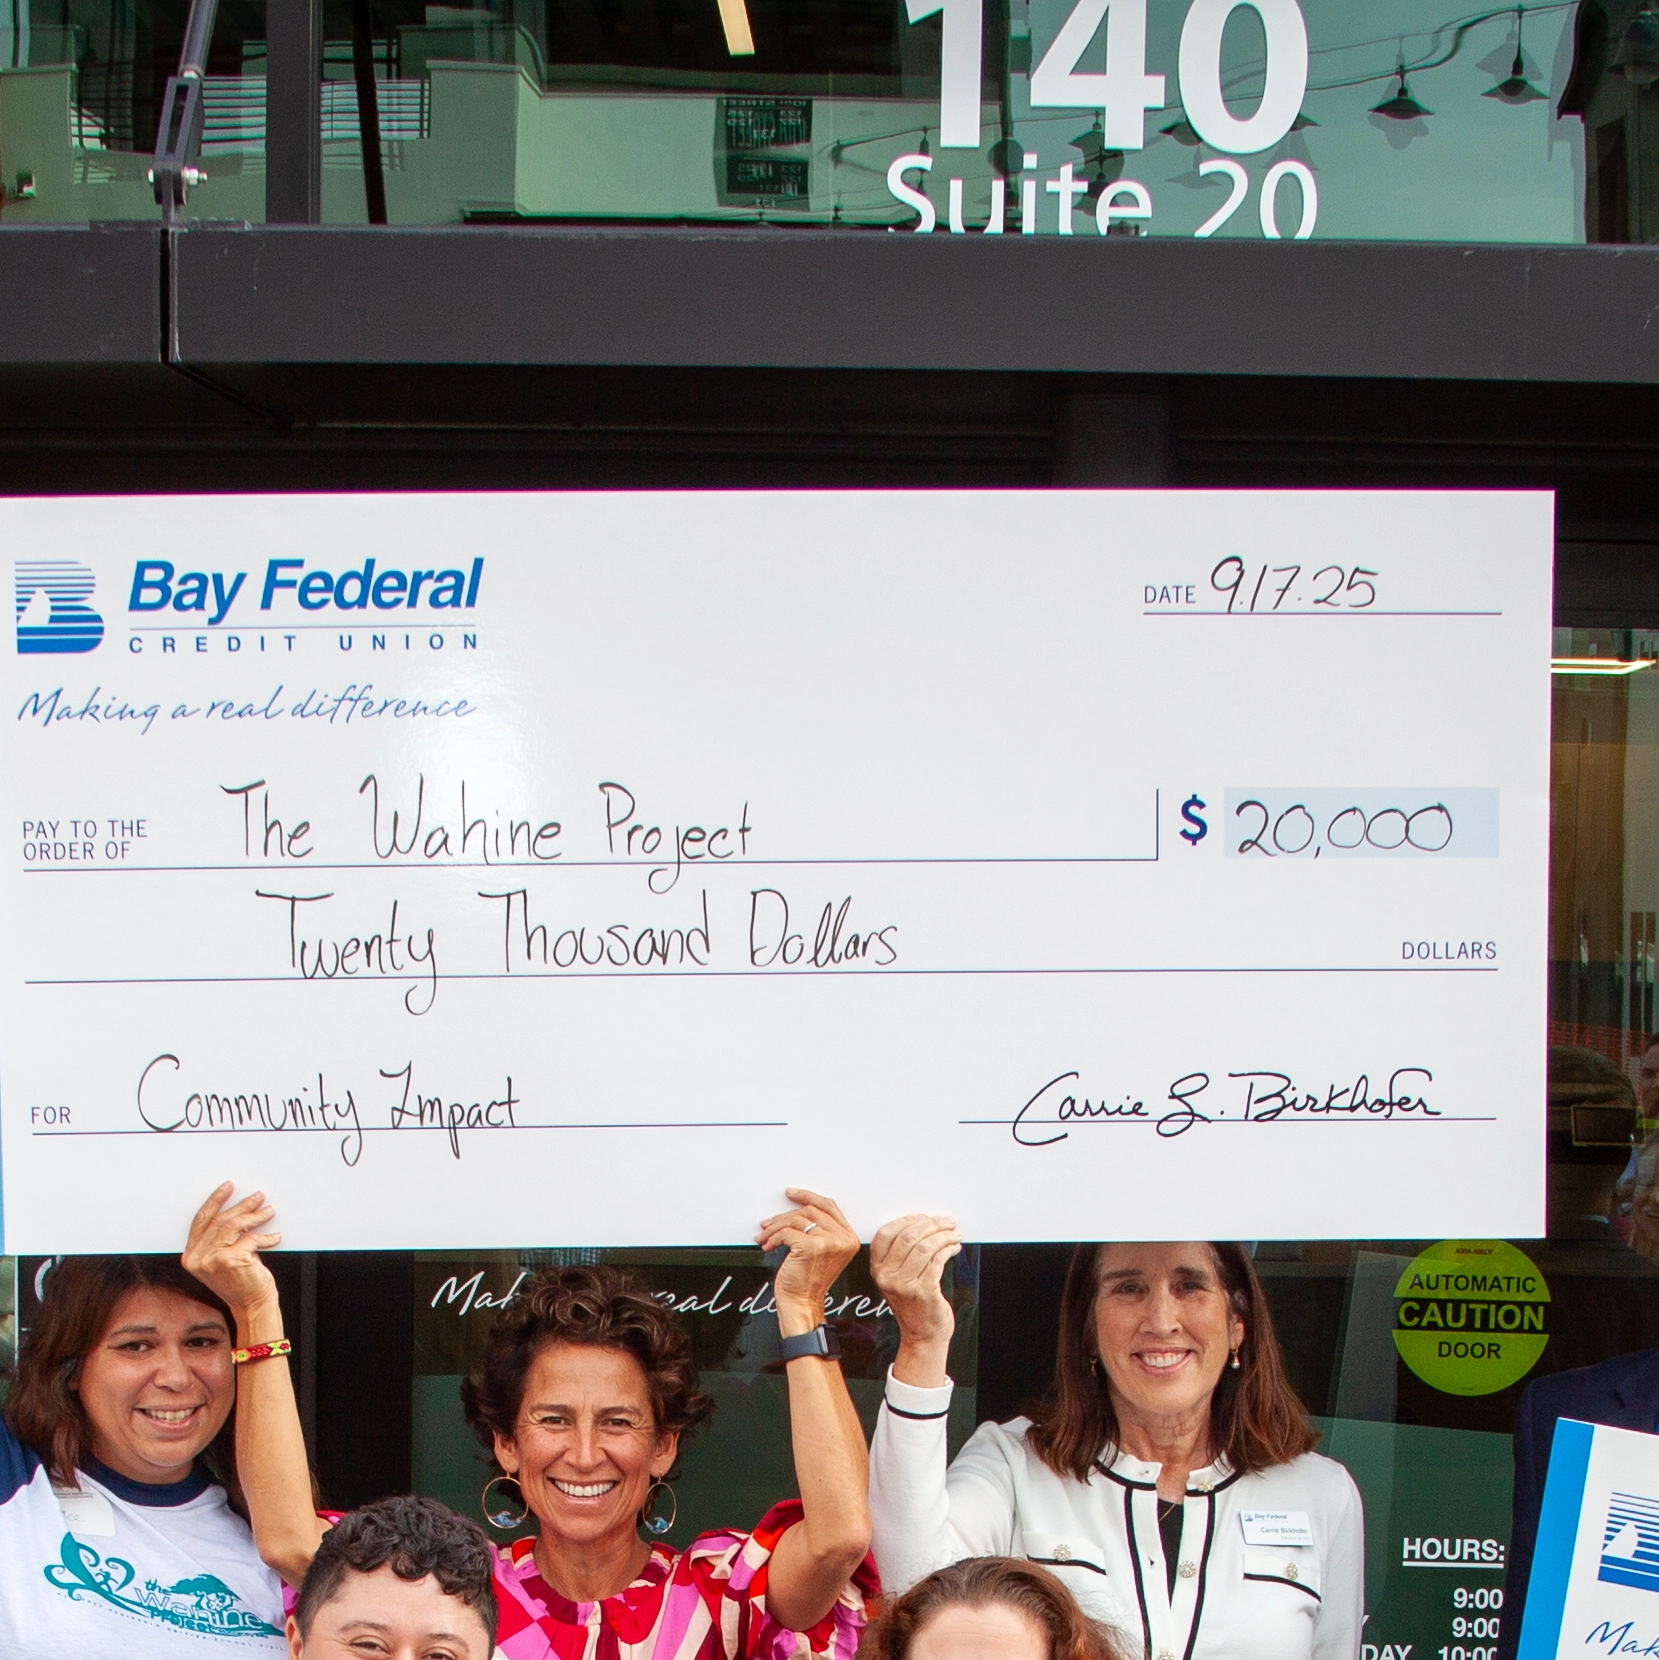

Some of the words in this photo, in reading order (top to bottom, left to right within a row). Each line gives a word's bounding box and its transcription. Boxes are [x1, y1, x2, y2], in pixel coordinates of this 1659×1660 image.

[905, 0, 1308, 154] 140
[887, 152, 1153, 236] Suite
[1194, 159, 1318, 239] 20
[128, 560, 247, 625] Bay
[260, 557, 484, 610] Federal
[1144, 585, 1195, 604] DATE
[129, 635, 296, 654] CREDIT
[340, 633, 477, 652] UNION
[17, 686, 160, 735] Making
[173, 704, 199, 721] a
[207, 685, 285, 722] real
[292, 685, 476, 724] difference
[23, 821, 59, 840] PAY
[70, 821, 97, 839] TO
[108, 820, 147, 838] THE
[220, 779, 314, 858] The
[359, 773, 562, 866] Wahine
[598, 781, 752, 894] Project
[1235, 801, 1452, 860] 20,000
[23, 843, 94, 860] ORDER
[105, 842, 130, 859] OF
[256, 890, 436, 1014] Twenty
[478, 890, 711, 973] Thousand
[750, 888, 897, 968] Dollars
[1401, 941, 1497, 960] DOLLARS
[31, 1106, 71, 1125] FOR
[138, 1054, 362, 1166] Community
[379, 1061, 519, 1159] Impact
[1409, 1274, 1536, 1293] AUTOMATIC
[1398, 1301, 1544, 1330] CAUTION
[1438, 1341, 1501, 1359] DOOR
[1403, 1538, 1505, 1561] HOURS:
[1453, 1588, 1503, 1609] 9:00
[1452, 1617, 1499, 1638] 9:00
